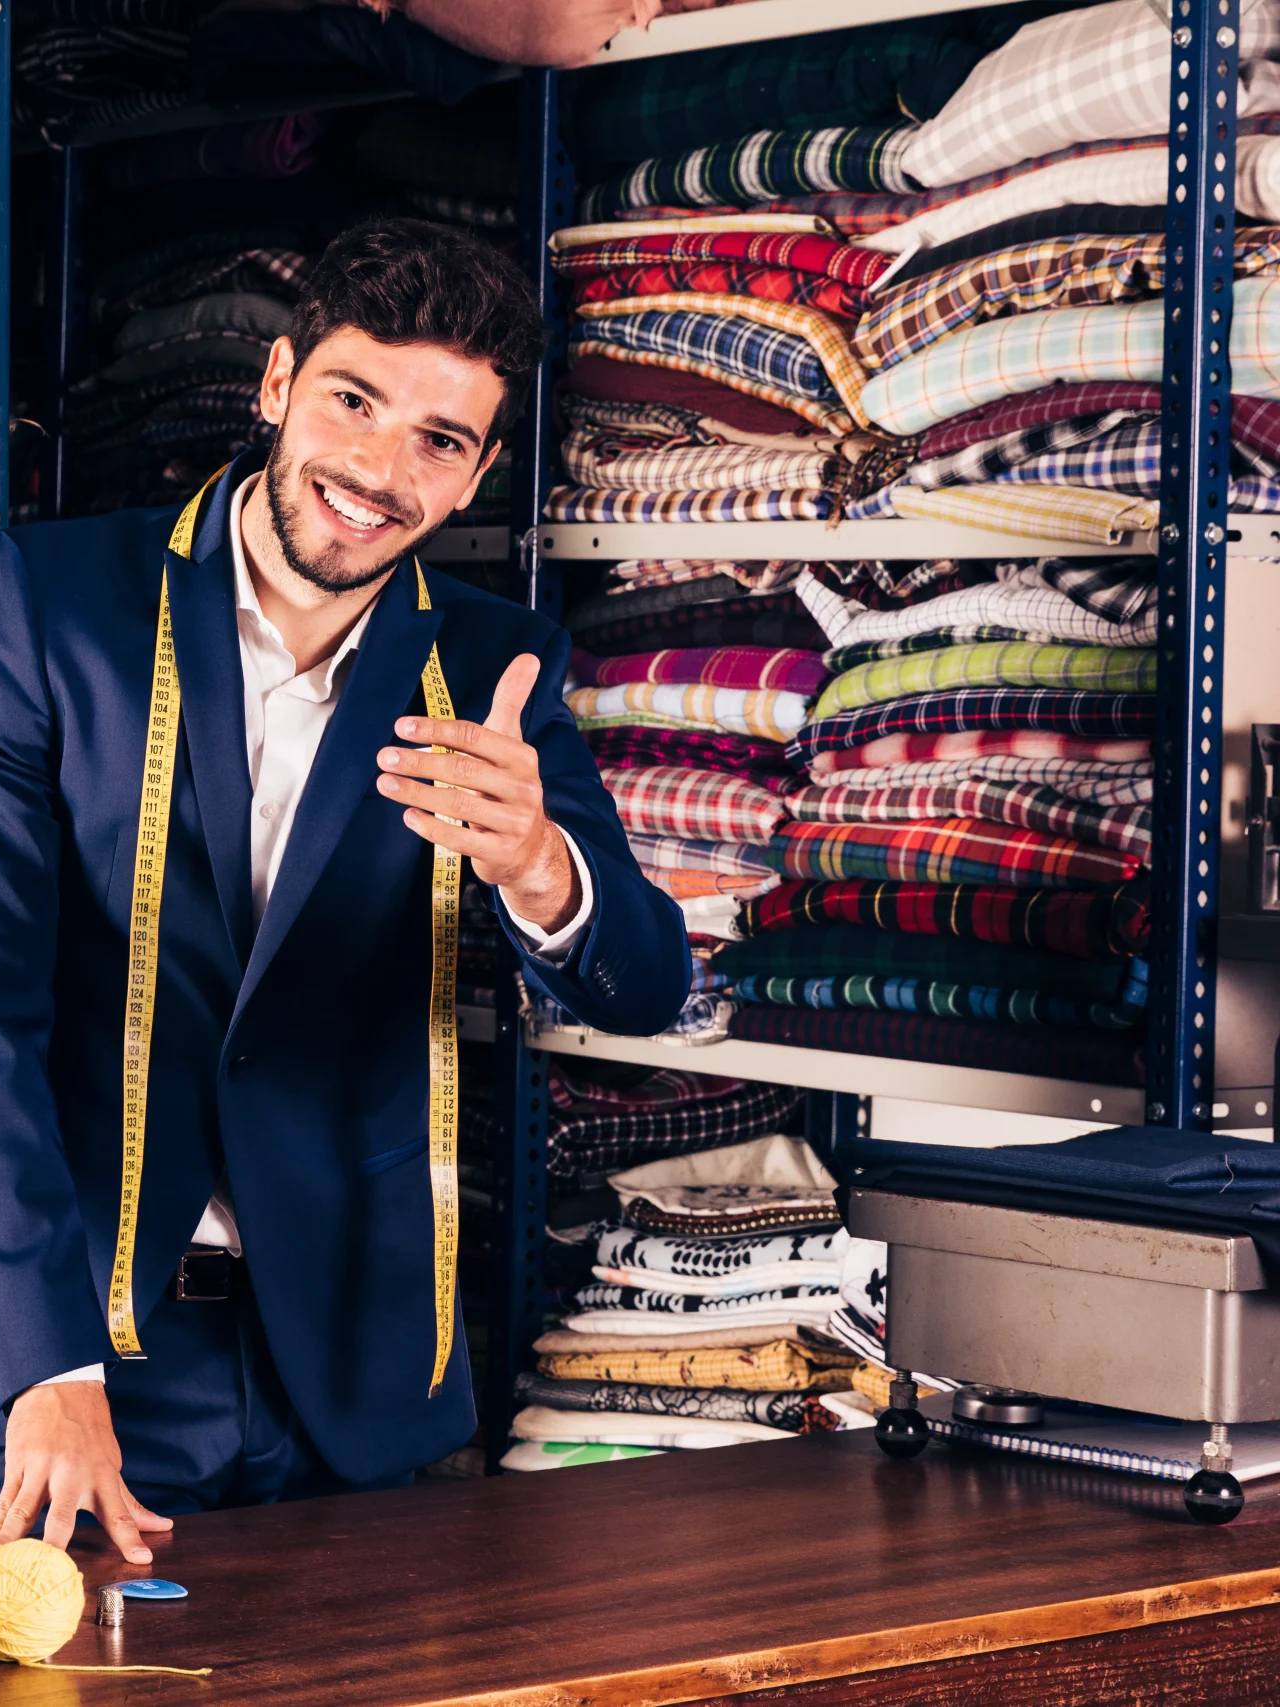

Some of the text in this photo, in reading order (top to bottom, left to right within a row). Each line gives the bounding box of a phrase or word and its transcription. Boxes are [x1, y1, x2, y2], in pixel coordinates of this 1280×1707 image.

[173, 536, 181, 544] 90
[163, 630, 172, 638] 98
[158, 653, 172, 662] 100
[158, 666, 170, 674] 101
[430, 666, 438, 675] 53
[157, 678, 170, 687] 102
[432, 676, 441, 685] 52
[156, 690, 169, 700] 103
[435, 686, 445, 695] 51
[438, 697, 448, 706] 50
[154, 703, 168, 713] 104
[440, 707, 450, 716] 49
[153, 716, 166, 726] 105
[152, 731, 165, 740] 106
[150, 745, 163, 754] 107
[149, 759, 162, 769] 108
[148, 773, 161, 783] 109
[146, 788, 159, 798] 110
[145, 802, 157, 812] 111
[144, 817, 157, 827] 112
[143, 831, 155, 841] 113
[141, 845, 154, 855] 114
[140, 859, 153, 869] 115
[447, 858, 456, 866] 38
[139, 874, 151, 883] 116
[446, 871, 456, 881] 37
[138, 888, 150, 898] 117
[445, 886, 455, 895] 36
[136, 903, 148, 912] 118
[445, 900, 455, 910] 35
[135, 917, 147, 926] 119
[445, 914, 454, 924] 34
[134, 931, 146, 941] 120
[445, 928, 454, 938] 33
[133, 945, 146, 955] 121
[445, 943, 454, 952] 32
[132, 960, 146, 970] 122
[445, 957, 453, 967] 31
[132, 974, 145, 984] 123
[444, 972, 453, 981] 30
[131, 988, 143, 998] 124
[443, 985, 452, 995] 29
[130, 1003, 142, 1012] 125
[443, 1000, 452, 1010] 28
[129, 1017, 141, 1027] 126
[442, 1014, 452, 1024] 27
[128, 1031, 140, 1040] 127
[442, 1028, 452, 1038] 26
[128, 1045, 139, 1055] 128
[443, 1043, 453, 1052] 25
[127, 1060, 138, 1070] 129
[443, 1057, 453, 1066] 24
[127, 1074, 138, 1083] 130
[444, 1071, 453, 1080] 23
[127, 1089, 137, 1098] 131
[444, 1086, 454, 1095] 22
[127, 1103, 137, 1113] 132
[444, 1100, 453, 1109] 21
[127, 1118, 136, 1127] 133
[443, 1114, 453, 1123] 20
[126, 1132, 136, 1141] 134
[443, 1128, 452, 1138] 19
[126, 1146, 135, 1156] 135
[443, 1142, 451, 1152] 18
[126, 1161, 135, 1170] 136
[443, 1157, 451, 1166] 17
[125, 1175, 133, 1185] 137
[444, 1171, 452, 1180] 16
[444, 1185, 453, 1194] 15
[124, 1190, 132, 1199] 138
[445, 1200, 453, 1209] 14
[446, 1214, 454, 1223] 13
[446, 1228, 454, 1237] 12
[445, 1242, 453, 1252] 11
[445, 1256, 452, 1266] 10
[115, 1275, 123, 1284] 144
[446, 1270, 450, 1280] 9
[113, 1289, 122, 1298] 145
[446, 1285, 449, 1295] 8
[112, 1303, 123, 1312] 146
[444, 1300, 448, 1309] 7
[112, 1317, 123, 1327] 147
[444, 1314, 449, 1324] 6
[114, 1331, 126, 1340] 148
